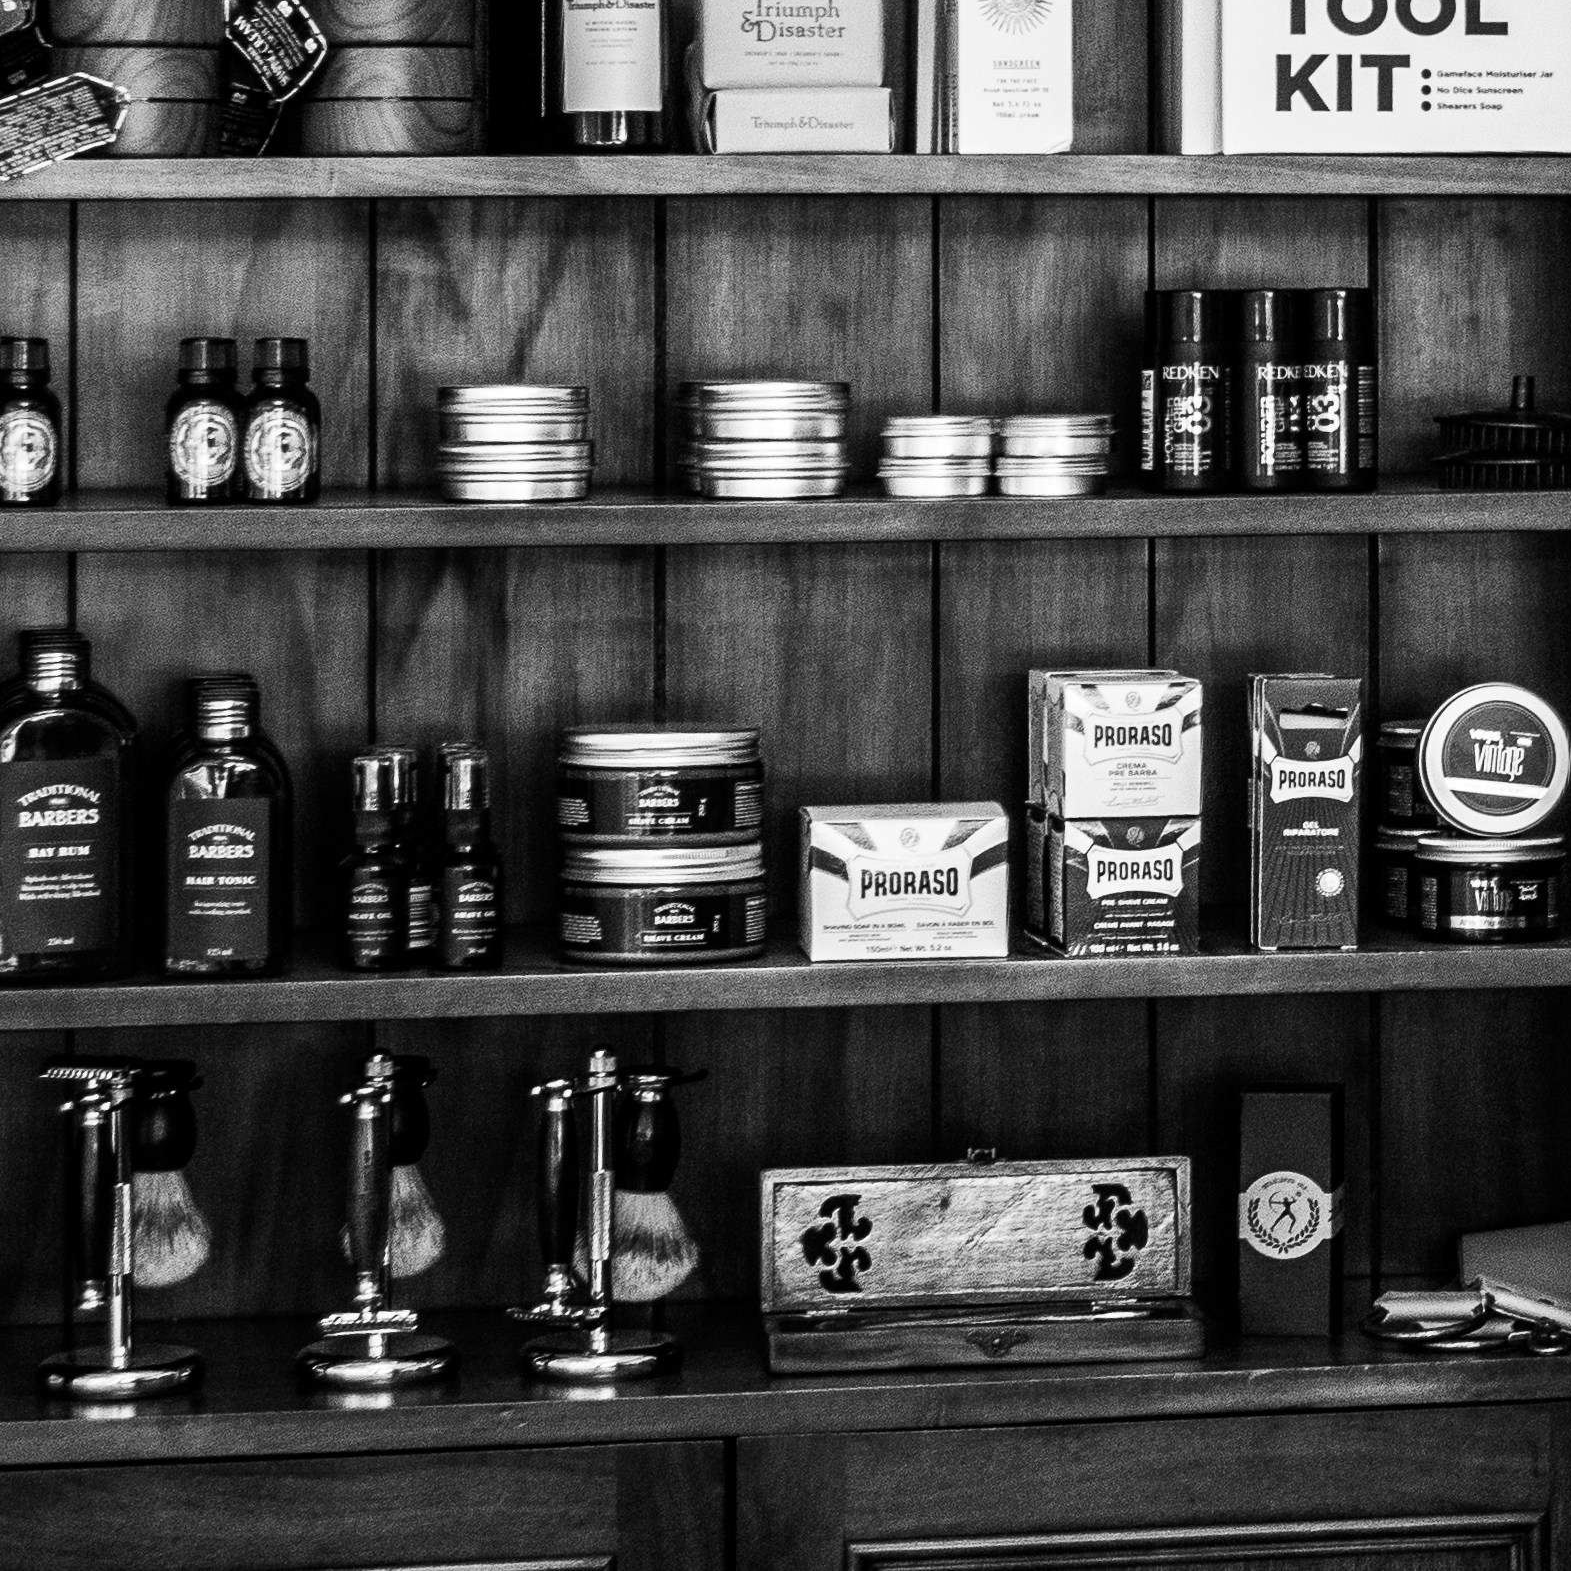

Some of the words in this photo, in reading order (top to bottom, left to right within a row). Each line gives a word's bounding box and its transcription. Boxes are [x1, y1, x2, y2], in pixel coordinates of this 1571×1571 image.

[740, 10, 847, 43] &Disaster
[1437, 70, 1483, 78] Gameface
[1486, 70, 1537, 78] Moisturiser
[1275, 53, 1411, 113] KIT
[1437, 86, 1450, 94] No
[1453, 86, 1473, 94] Dice
[1476, 86, 1524, 94] Sunscreen
[1437, 102, 1477, 110] Shearers
[1480, 102, 1503, 111] Soap
[1162, 365, 1219, 380] REDKEN
[1257, 365, 1300, 380] REDKE
[1304, 364, 1348, 379] EDKEN
[1314, 394, 1340, 433] 03
[1094, 723, 1172, 749] PRORASO
[1116, 762, 1147, 770] CREMA
[1128, 769, 1158, 777] BARBA
[1279, 769, 1345, 790] PRORASO
[17, 783, 101, 807] TRADITIONAL
[638, 797, 680, 808] BARBERS
[18, 808, 100, 828] BARBERS
[628, 816, 656, 826] SHAVE
[657, 816, 690, 825] CREAM
[1302, 821, 1319, 829] GEL
[187, 823, 256, 842] TRADITIONAL
[1282, 828, 1339, 837] RIPARATORE
[28, 847, 56, 859] BAY
[57, 845, 91, 857] RUM
[188, 844, 255, 859] BARBERS
[1097, 858, 1173, 884] PRORASO
[185, 875, 215, 885] HAIR
[217, 875, 257, 885] TONIC
[860, 867, 959, 899] PRORASO
[654, 914, 695, 926] BARBERS
[643, 933, 672, 943] SHAVE
[673, 933, 705, 942] CREAM
[900, 944, 913, 952] Net
[930, 944, 943, 952] 5.2
